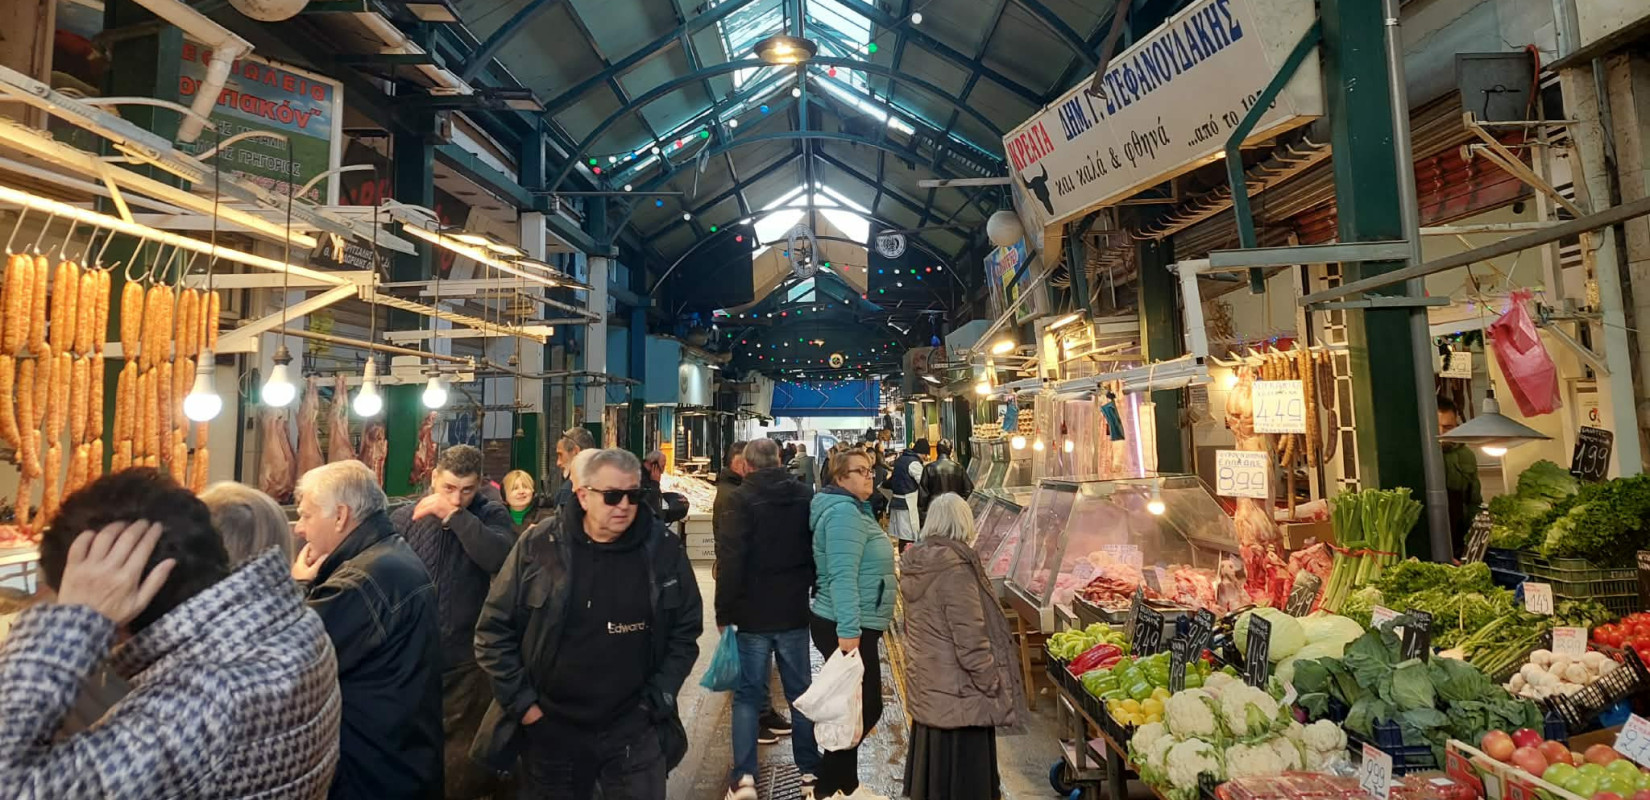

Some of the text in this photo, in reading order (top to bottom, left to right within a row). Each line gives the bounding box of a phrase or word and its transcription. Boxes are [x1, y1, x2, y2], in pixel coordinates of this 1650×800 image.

[1058, 95, 1092, 142] ΔΗΜ.
[1101, 0, 1244, 116] ΣΤΕΦΑΝΟΥΔΑΚΗΣ
[1006, 120, 1055, 173] ΚΡΕΑΤΑ
[1222, 110, 1240, 129] το
[1075, 150, 1108, 187] καλά
[1108, 146, 1122, 170] &
[1123, 115, 1171, 169] φθηνά
